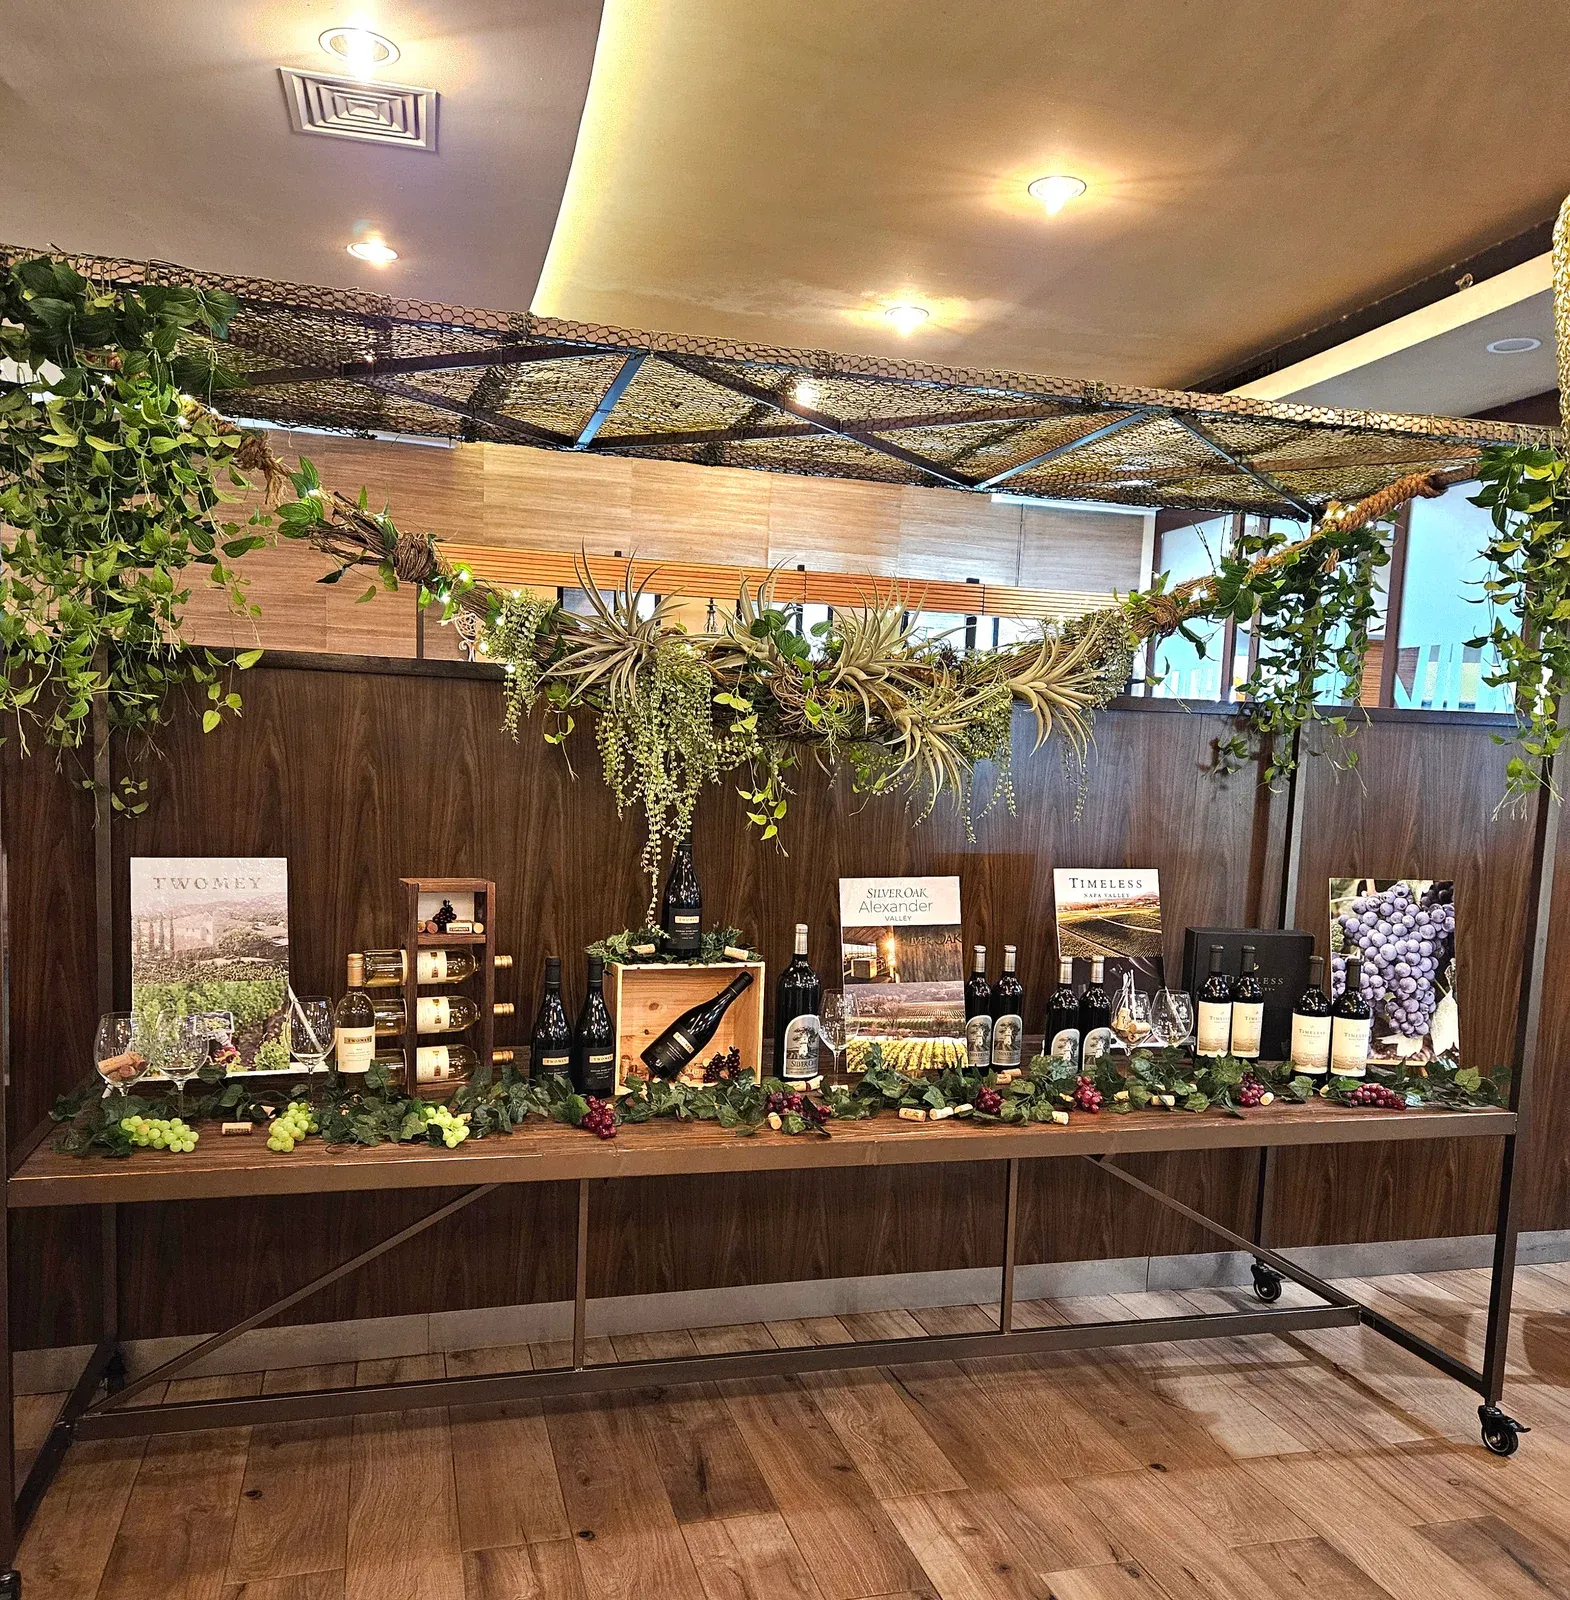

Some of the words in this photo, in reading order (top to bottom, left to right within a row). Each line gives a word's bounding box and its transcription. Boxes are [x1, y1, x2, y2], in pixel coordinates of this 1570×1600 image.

[153, 877, 261, 890] TWOMEY
[1068, 877, 1143, 889] TIMELESS
[866, 887, 904, 899] SILVER
[903, 887, 929, 899] OAK
[858, 899, 933, 913] Alexander
[1222, 974, 1284, 985] TILESS
